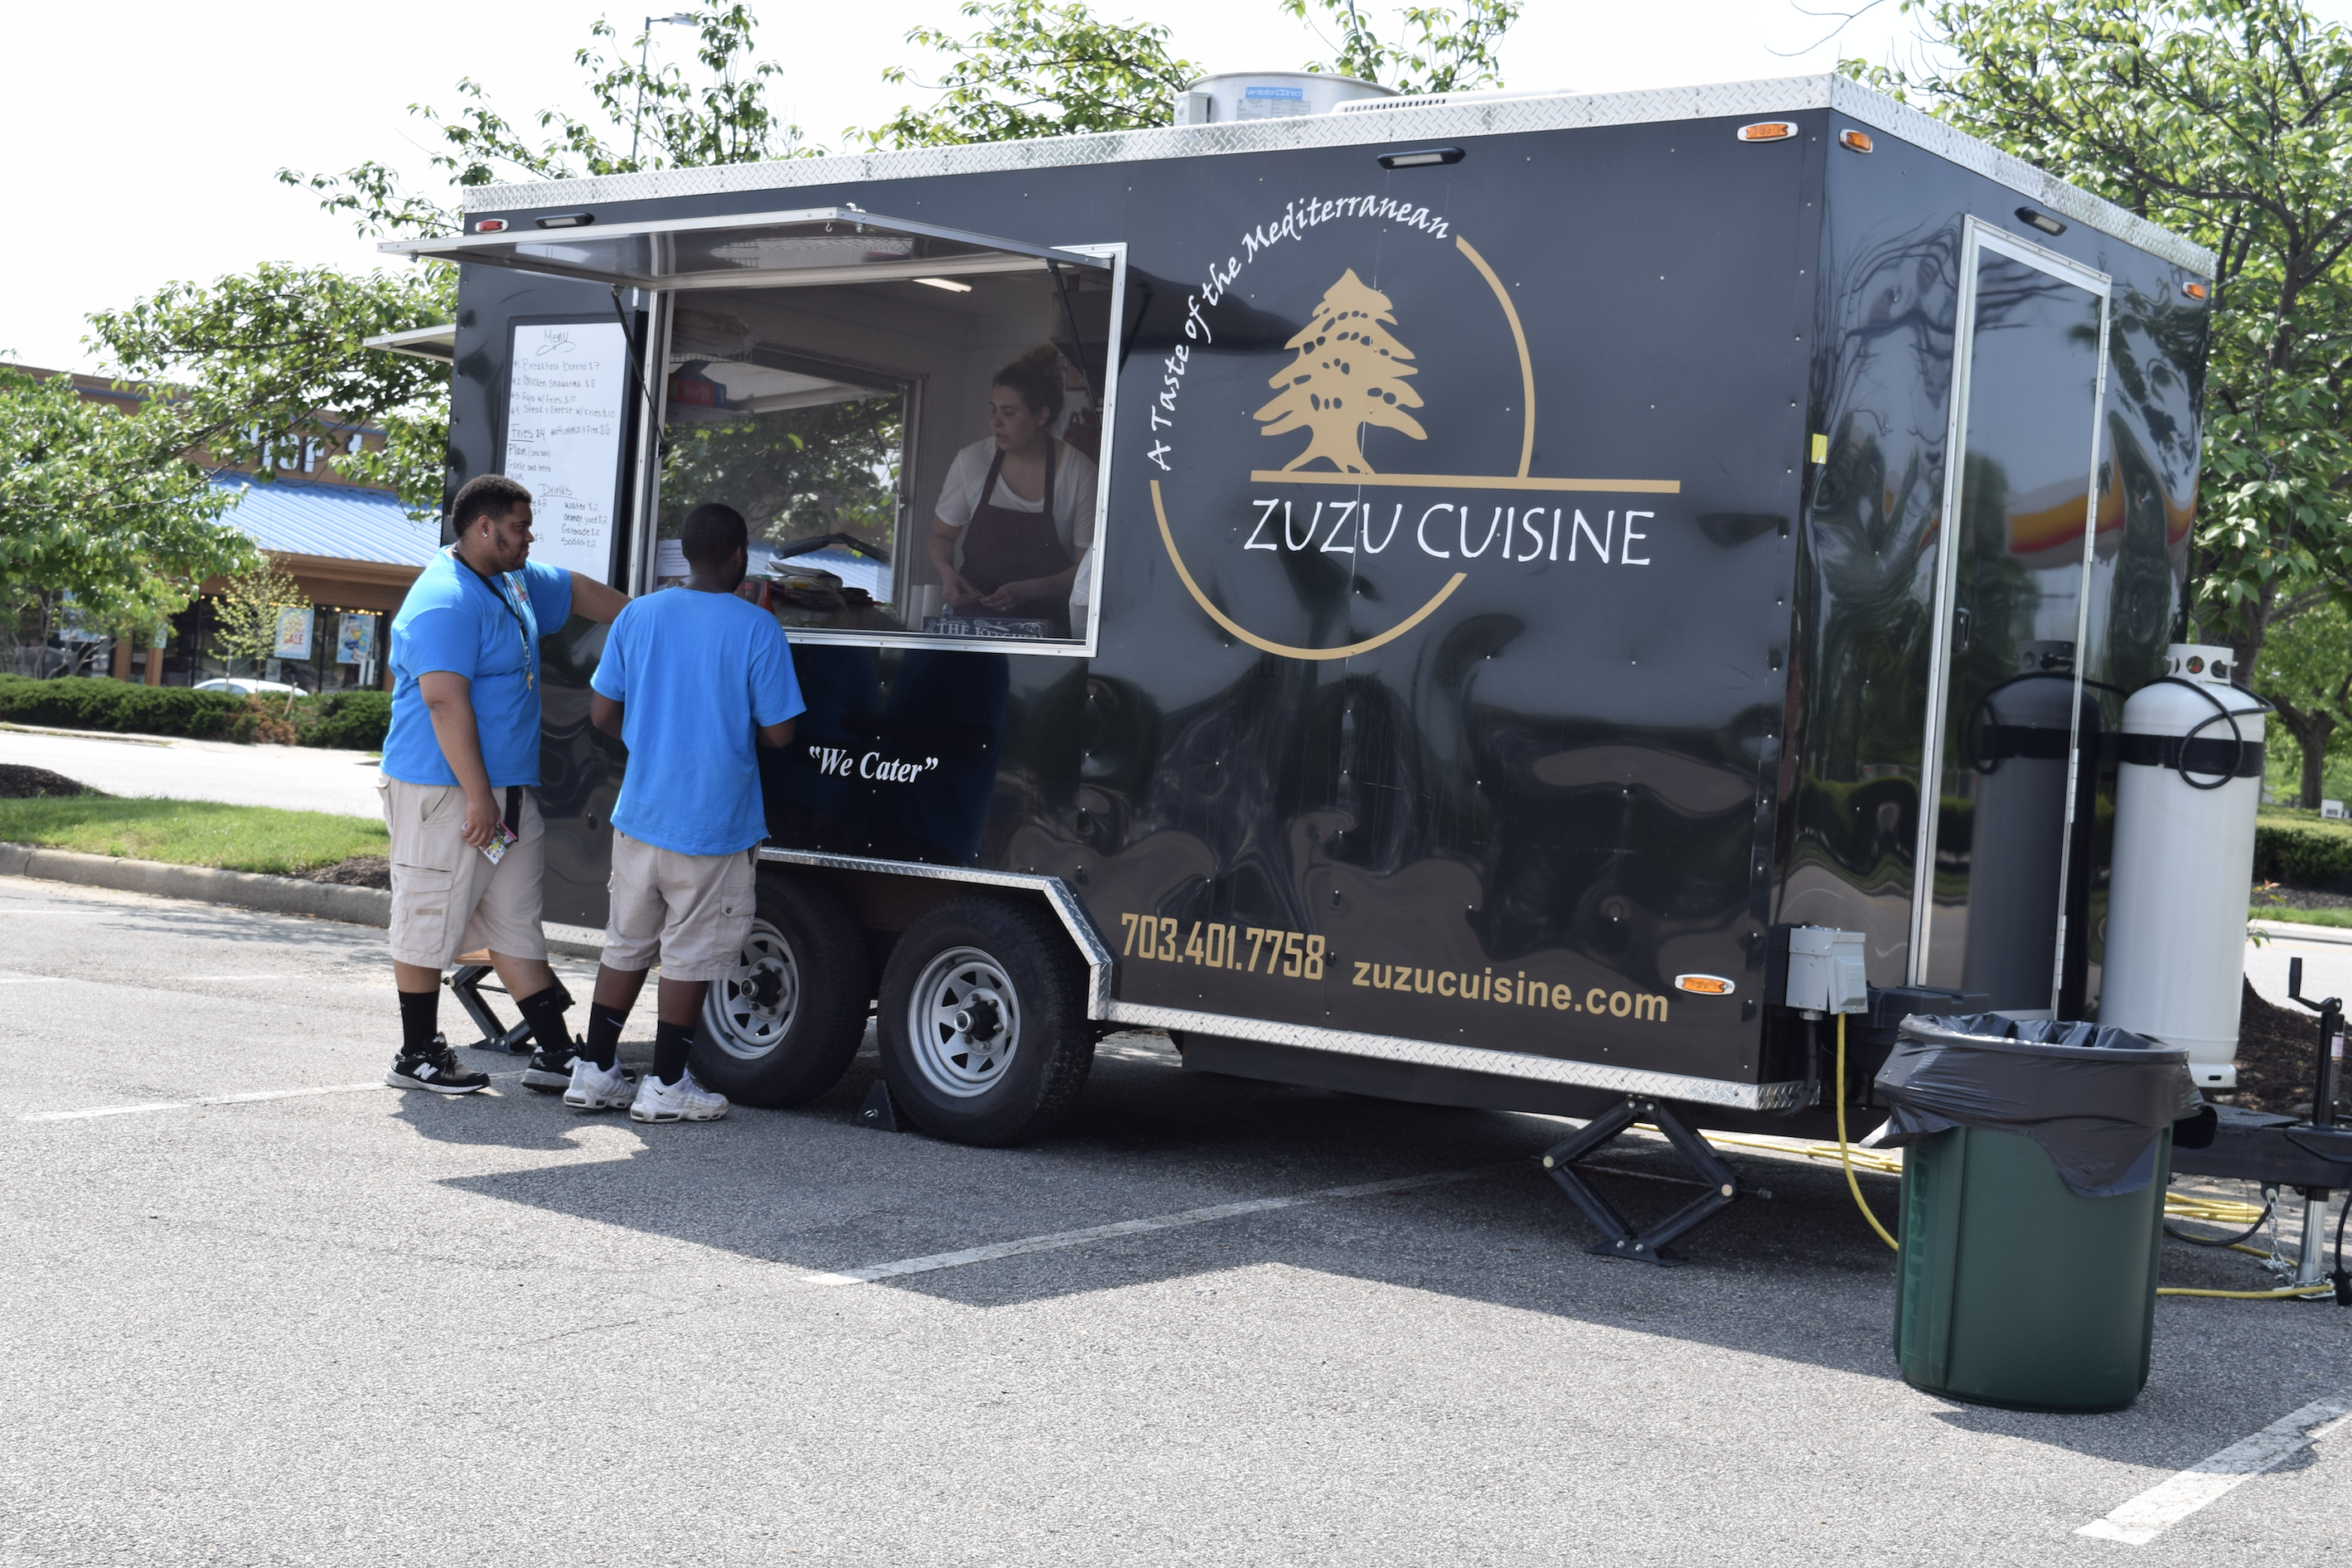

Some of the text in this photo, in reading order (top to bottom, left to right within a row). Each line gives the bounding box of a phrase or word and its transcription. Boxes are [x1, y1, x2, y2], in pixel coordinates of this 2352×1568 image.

[1282, 89, 1302, 97] Direct
[544, 328, 569, 344] Menu
[1147, 195, 1449, 472] A Taste of the Mediterranean
[522, 358, 559, 371] Breakfast
[524, 375, 547, 388] Chicken
[522, 391, 535, 405] Gyro
[524, 404, 544, 414] Steak
[549, 405, 573, 414] Cheese
[510, 423, 535, 439] Fries
[507, 443, 527, 457] Plain
[506, 458, 525, 472] Garlic
[538, 463, 552, 473] herb
[506, 471, 524, 483] Cajun
[538, 483, 573, 496] Drinks
[564, 501, 600, 512] water $2
[564, 513, 583, 526] orange
[561, 523, 590, 536] Gatorade
[1243, 498, 1655, 566] ZUZU CUISINE
[561, 537, 586, 546] Sodas
[1121, 912, 1325, 980] 703.401.7758
[1352, 961, 1668, 1022] zuzucuisine.com
